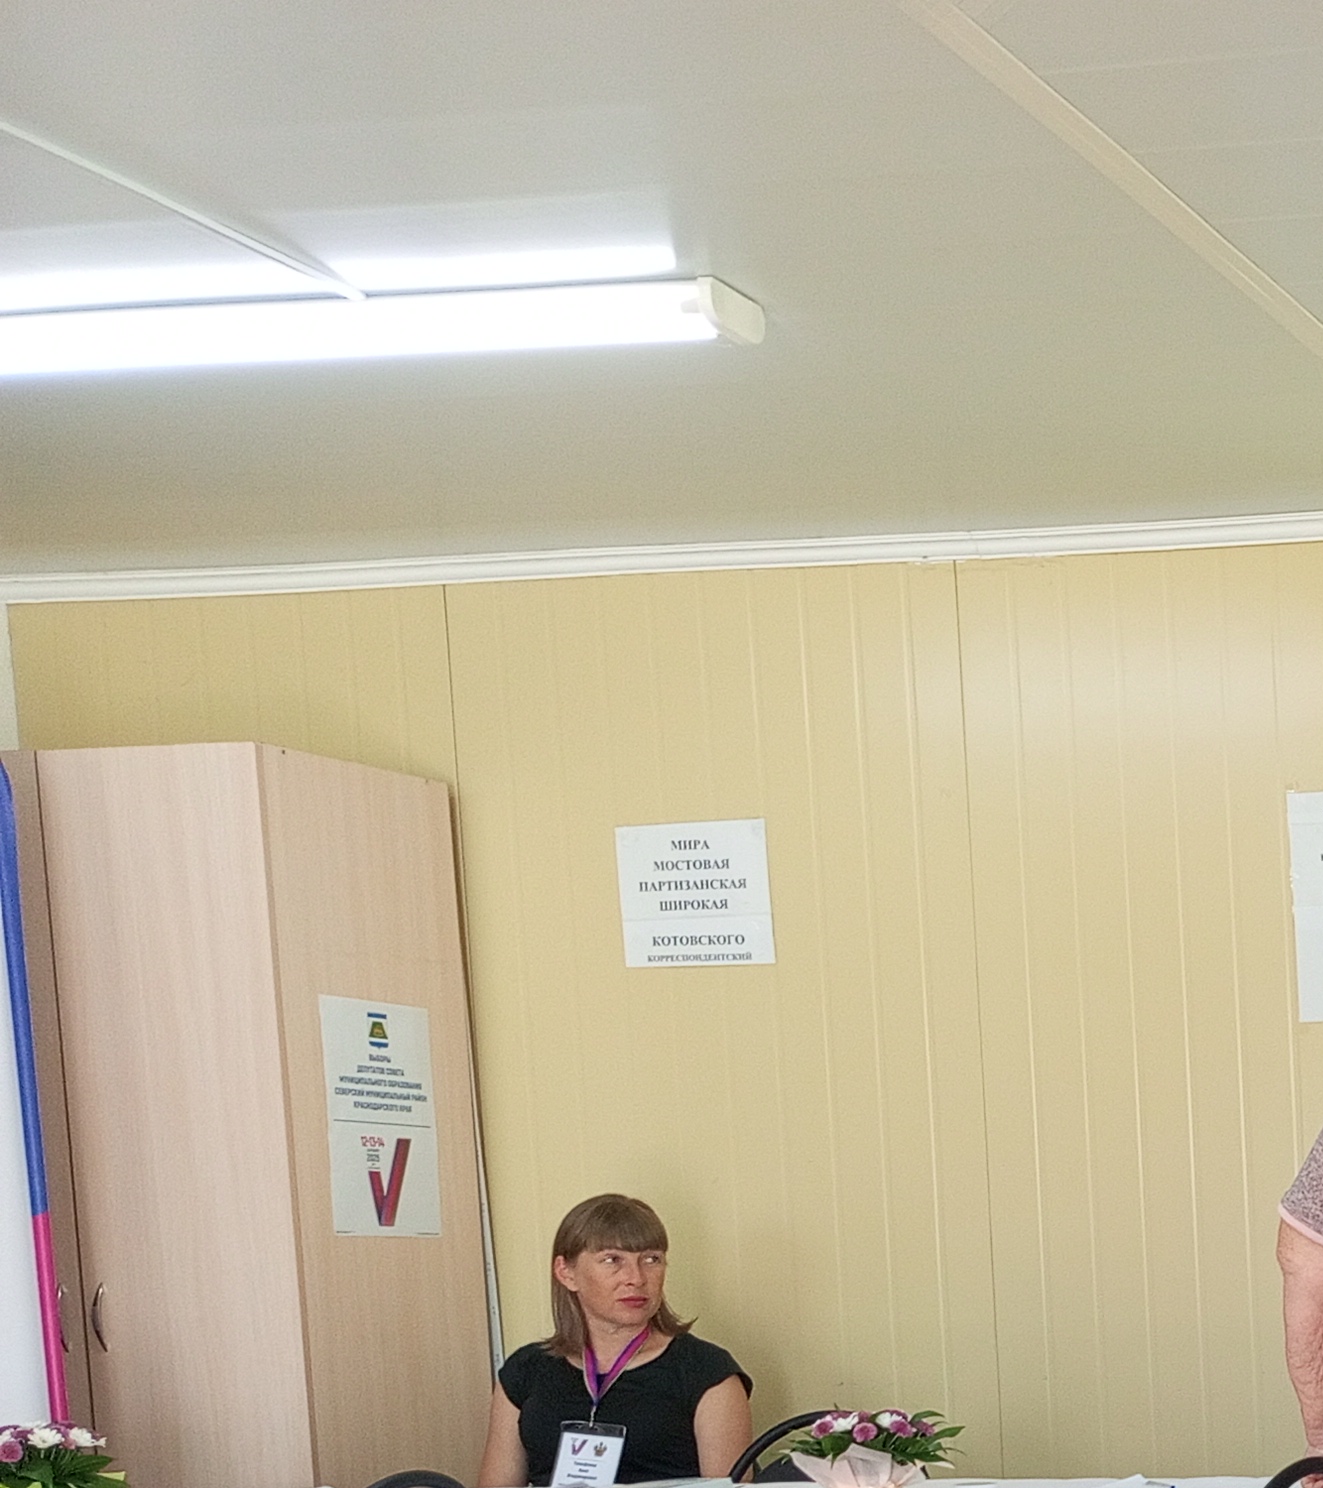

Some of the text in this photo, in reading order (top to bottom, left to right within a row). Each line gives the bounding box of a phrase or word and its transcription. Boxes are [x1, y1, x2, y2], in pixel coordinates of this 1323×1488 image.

[671, 840, 710, 851] МИРА
[653, 859, 730, 871] МОСТОВАЯ
[639, 878, 747, 892] ПАРТИЗАНСКАЯ
[659, 899, 728, 911] ШИРОКАЯ
[652, 934, 745, 946] КОТОВСКОГО
[647, 952, 752, 963] КОРРЕСПОНДЕНТСКИЙ
